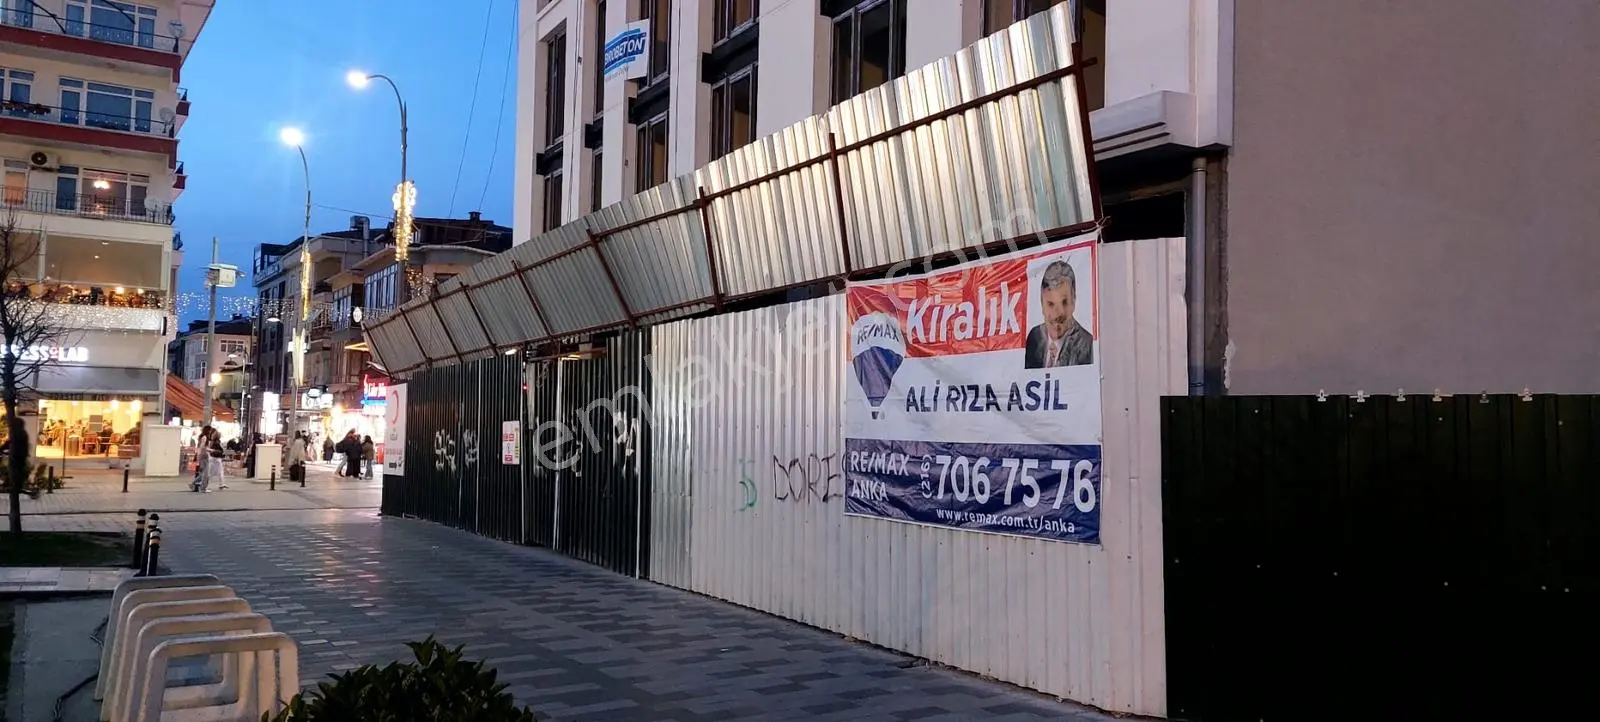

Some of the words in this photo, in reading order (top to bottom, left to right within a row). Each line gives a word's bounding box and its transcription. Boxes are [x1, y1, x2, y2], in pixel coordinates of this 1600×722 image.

[906, 281, 1022, 344] Kiralık
[856, 321, 900, 346] RE/MAX
[906, 380, 941, 413] ALİ
[946, 383, 1001, 413] RIZA
[1007, 373, 1068, 412] ASİL
[849, 451, 910, 476] RE/MAX
[849, 480, 889, 502] ANKA
[921, 454, 933, 499] (216)
[936, 455, 991, 504] 706
[1001, 458, 1041, 508] 75
[1051, 459, 1096, 513] 76
[936, 507, 1075, 534] www.remax.com.tr/anka
